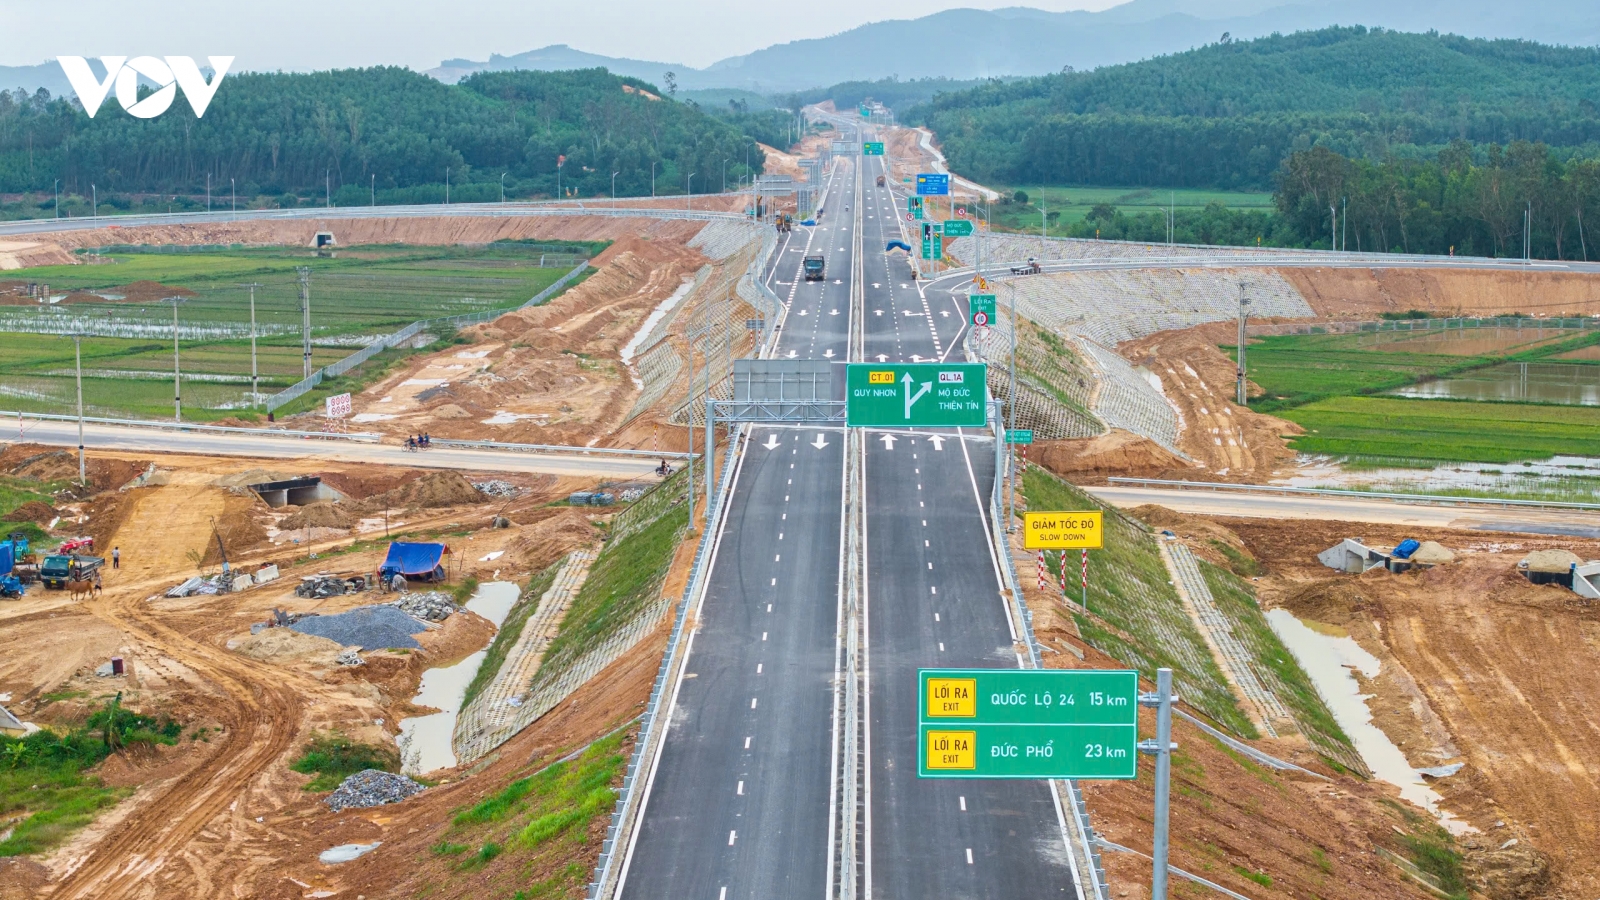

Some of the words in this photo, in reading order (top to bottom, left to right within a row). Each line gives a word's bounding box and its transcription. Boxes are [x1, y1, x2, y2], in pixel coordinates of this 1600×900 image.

[940, 374, 962, 382] QL.1A
[854, 389, 870, 397] QUY
[874, 388, 896, 396] NHƠN
[938, 388, 950, 398] MỘ
[953, 386, 970, 397] ĐỨC
[939, 400, 962, 411] THIỆN
[966, 400, 979, 410] TÍN
[1032, 518, 1056, 529] GIẢM
[1060, 516, 1078, 529] TỐC
[1081, 518, 1094, 530] ĐỘ
[935, 683, 950, 699] LỐI
[954, 687, 968, 699] RA
[991, 689, 1027, 706] QUỐC
[1035, 691, 1052, 708] LỘ
[1059, 694, 1075, 706] 24
[1089, 692, 1103, 706] 15
[1106, 694, 1127, 706] km
[943, 702, 960, 712] EXIT
[934, 735, 950, 751] LỐI
[954, 739, 968, 751] RA
[991, 742, 1018, 758] ĐỨC
[1026, 740, 1054, 757] PHỔ
[1085, 744, 1103, 758] 23
[1106, 746, 1126, 758] km
[943, 754, 959, 764] EXIT
